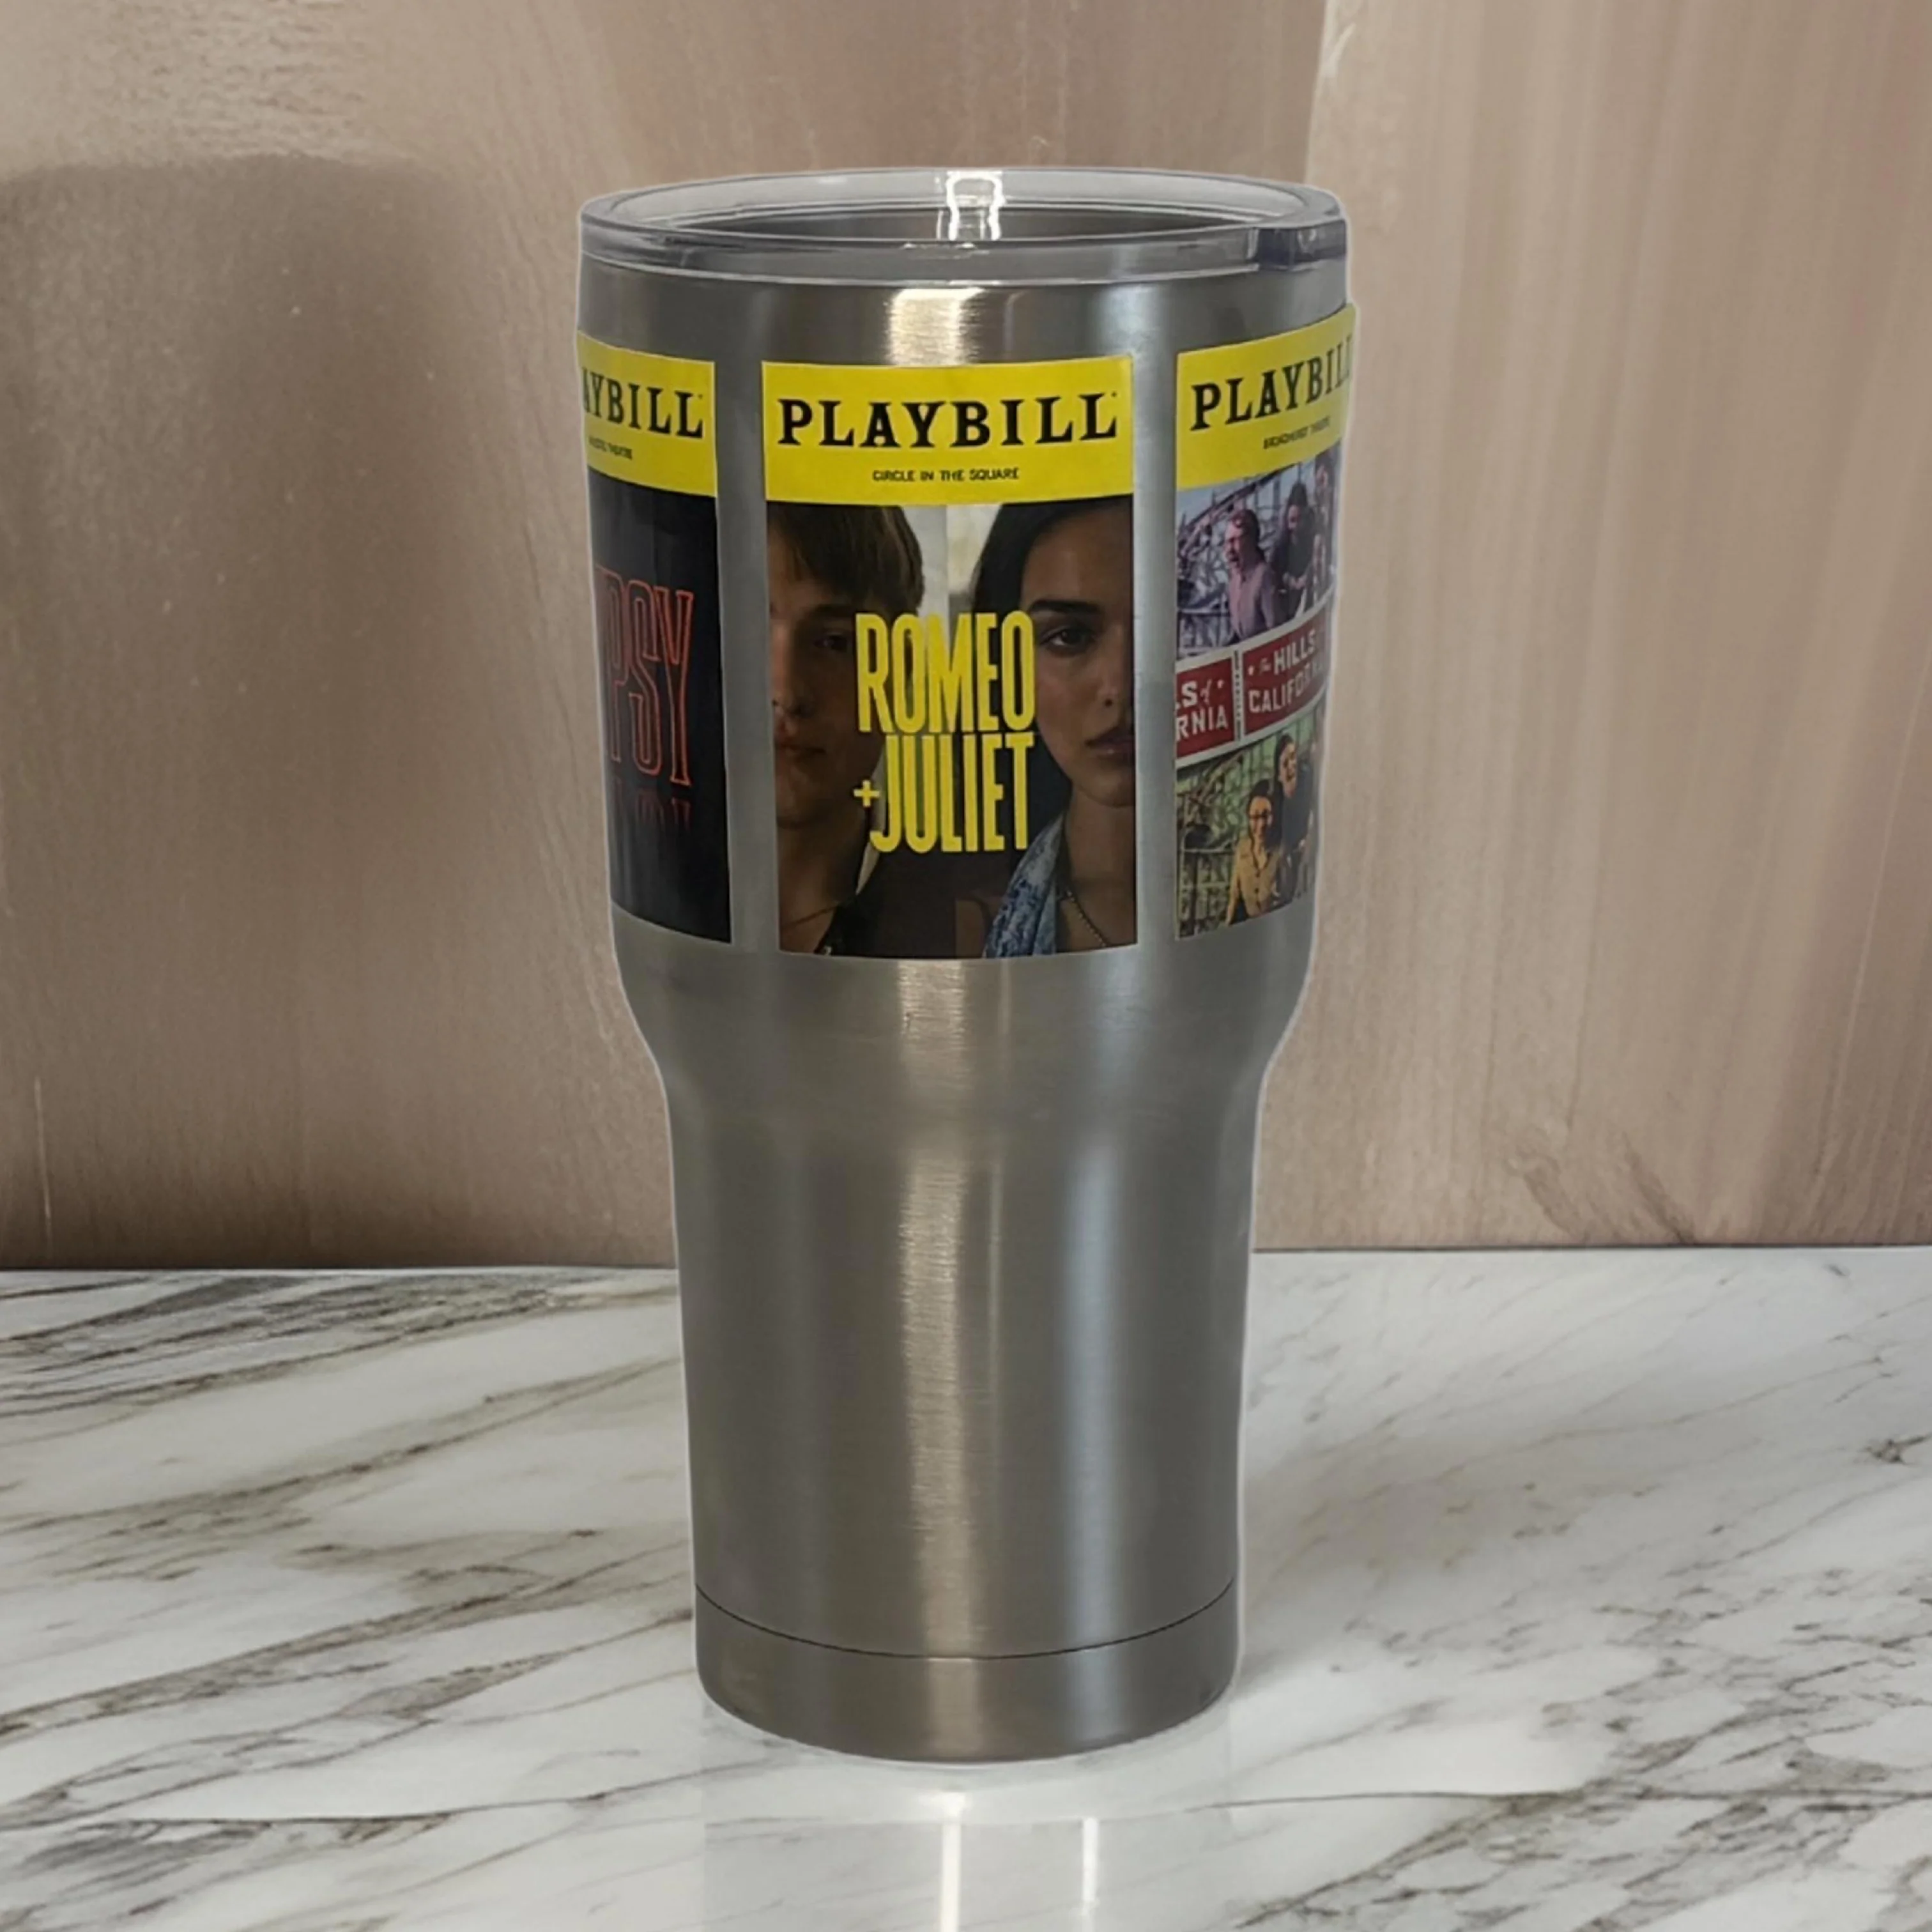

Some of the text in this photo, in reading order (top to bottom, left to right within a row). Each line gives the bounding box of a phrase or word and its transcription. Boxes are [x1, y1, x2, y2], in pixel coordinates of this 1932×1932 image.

[778, 393, 1117, 447] PLAYBILL
[873, 467, 1020, 482] CIRCLE IN THE SQUARE
[855, 610, 1036, 733] ROMEO
[1273, 629, 1316, 675] HILLS
